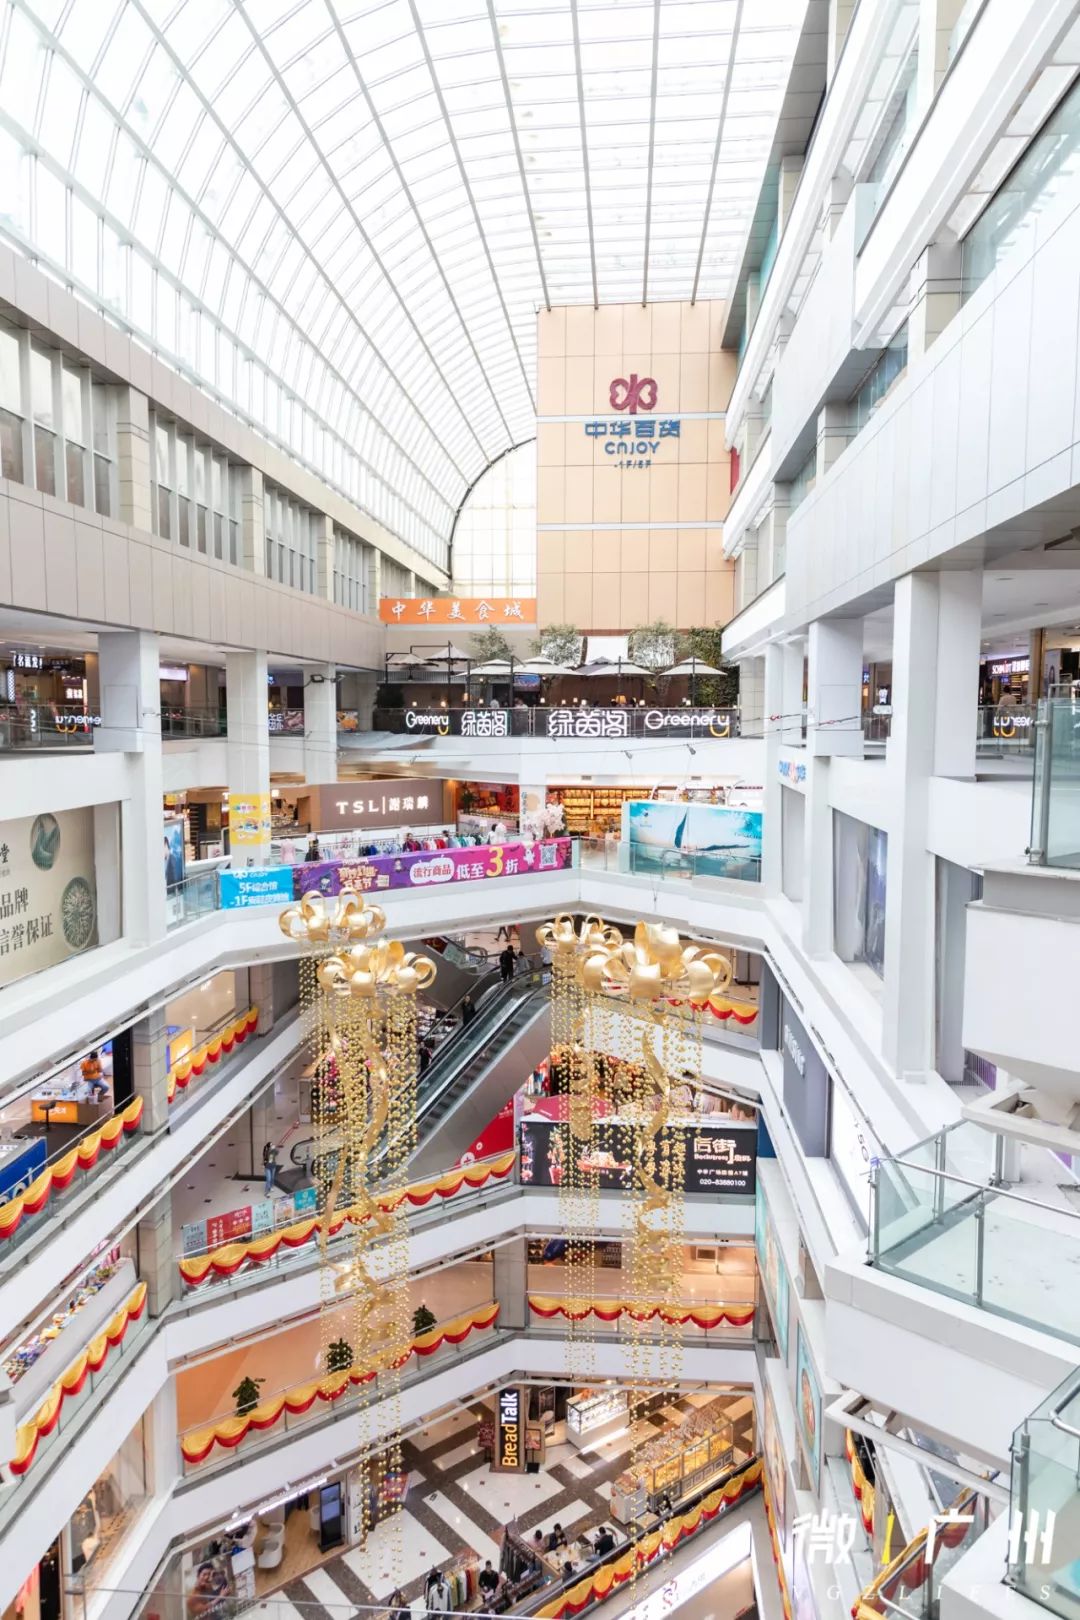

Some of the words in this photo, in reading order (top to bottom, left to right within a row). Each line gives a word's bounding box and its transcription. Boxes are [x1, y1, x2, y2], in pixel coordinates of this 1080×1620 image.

[584, 419, 681, 439] 中华百货
[391, 601, 524, 621] 中华美食城
[405, 710, 449, 736] Greenery
[461, 710, 508, 737] 绿茵阁
[547, 710, 628, 737] 绿茵阁
[644, 710, 730, 738] Greenery
[335, 799, 380, 815] TSL
[412, 863, 452, 879] 流行商品
[456, 846, 519, 881] 低至3折
[0, 887, 29, 919] 品牌
[693, 1136, 737, 1165] 后街
[500, 1391, 519, 1467] BreadTalk
